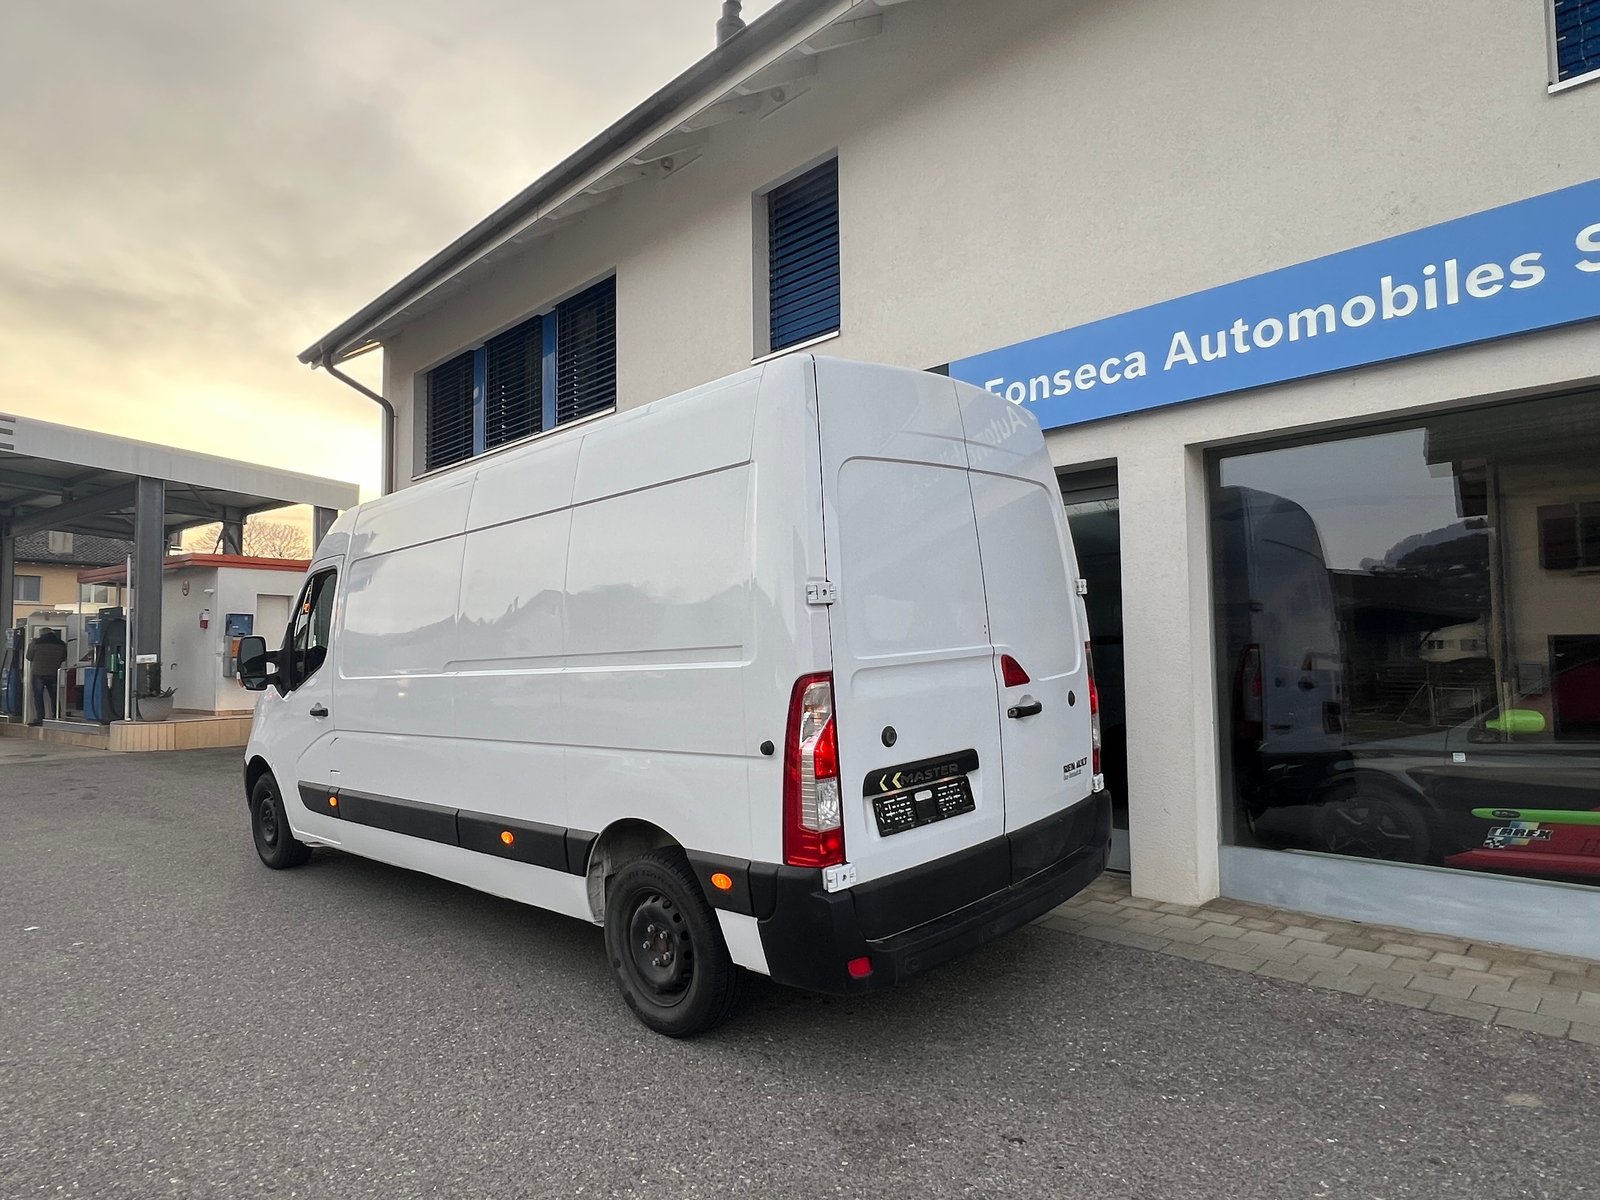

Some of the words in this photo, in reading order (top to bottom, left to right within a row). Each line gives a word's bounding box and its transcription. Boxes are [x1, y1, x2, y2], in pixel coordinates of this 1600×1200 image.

[985, 350, 1147, 407] Fonseca
[1164, 248, 1546, 371] Automobiles
[901, 764, 958, 784] MASTER
